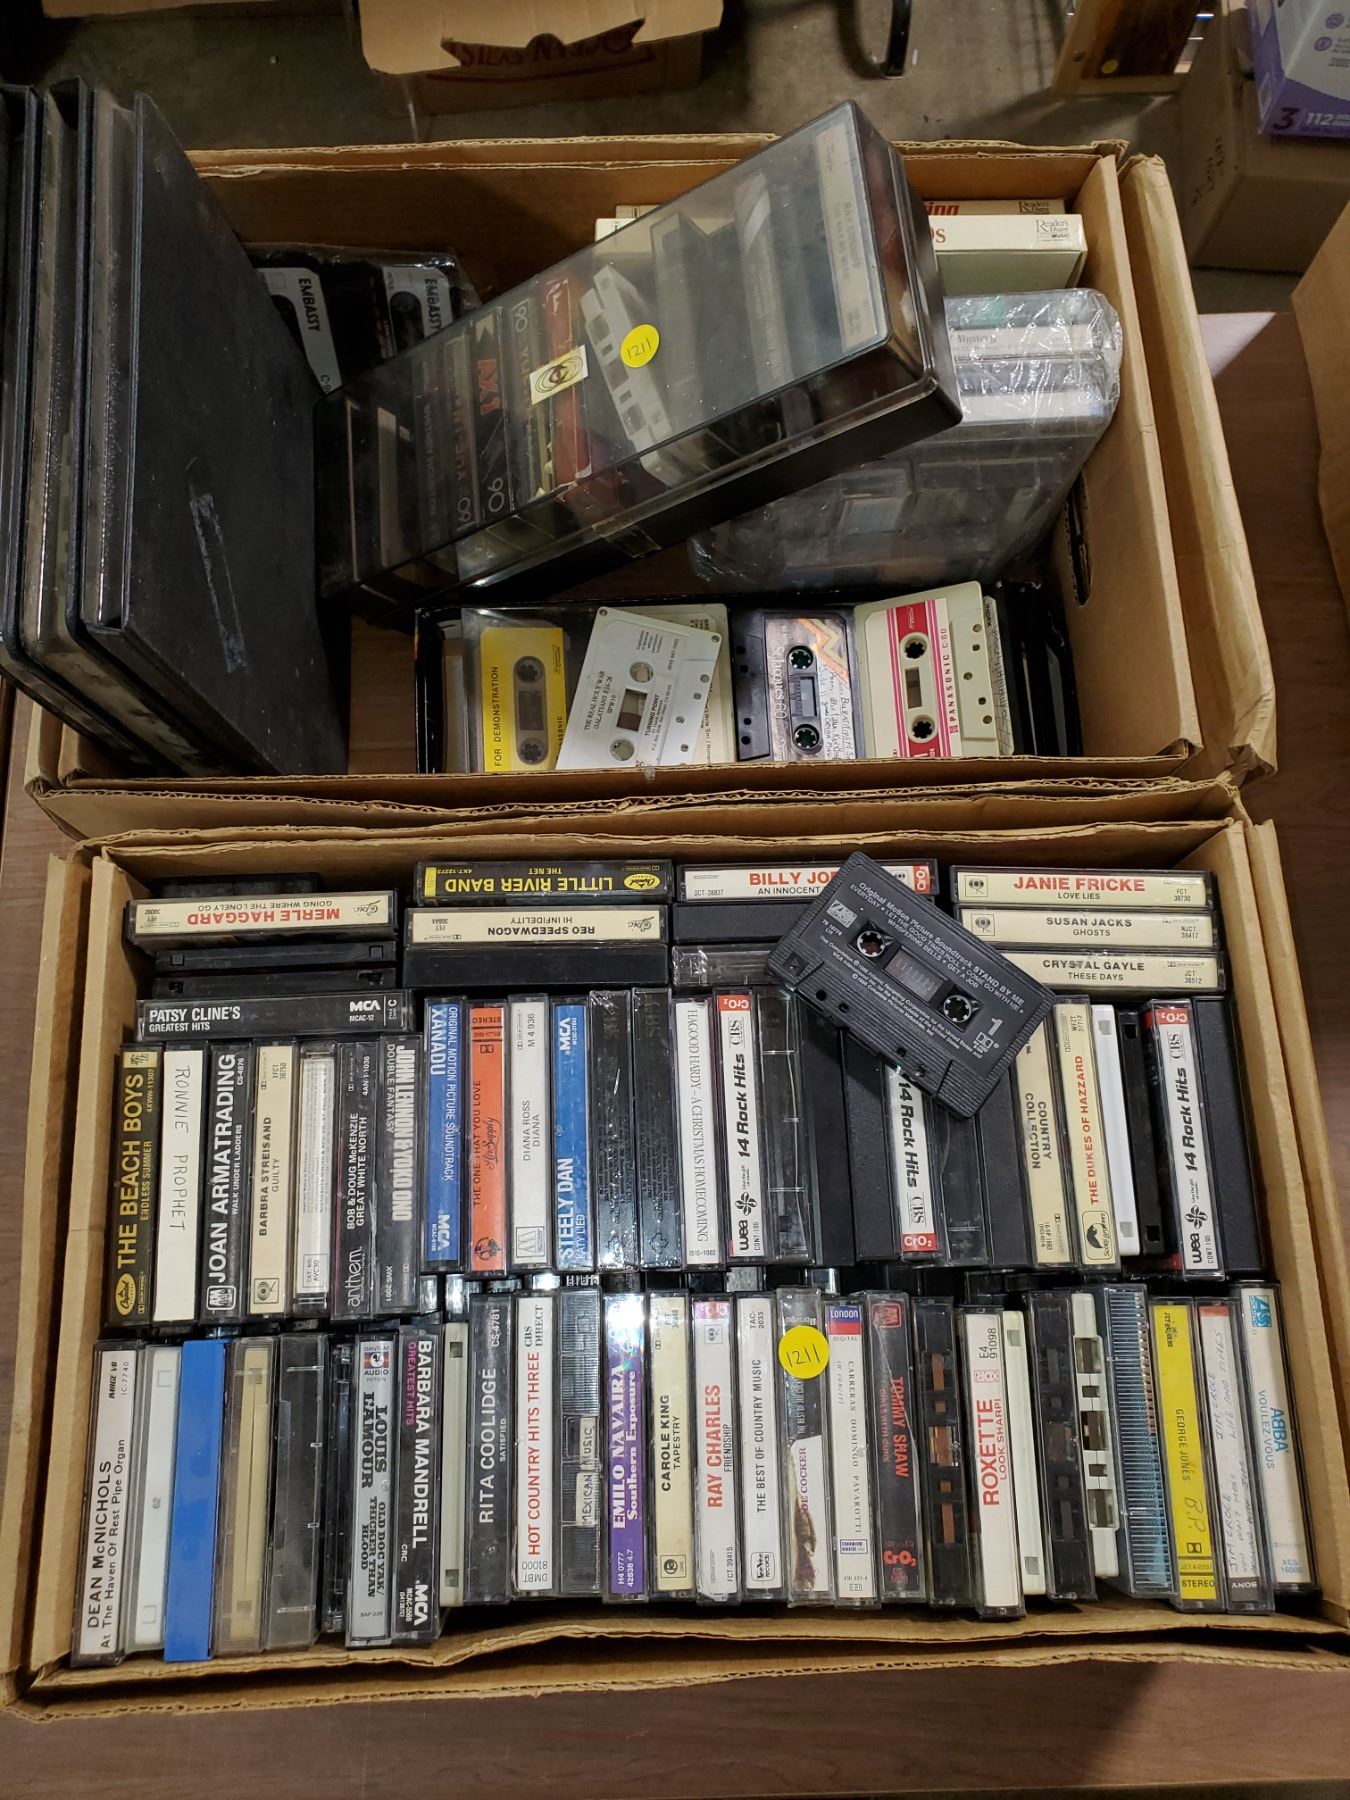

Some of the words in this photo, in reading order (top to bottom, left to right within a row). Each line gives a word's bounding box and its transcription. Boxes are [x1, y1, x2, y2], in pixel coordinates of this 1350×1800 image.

[1272, 107, 1299, 129] 3
[1306, 112, 1333, 125] 112
[298, 277, 320, 332] EMBASSY
[628, 338, 652, 359] 1211
[487, 476, 504, 512] 90
[940, 628, 948, 649] C-60
[591, 685, 601, 702] HOLY
[595, 671, 605, 684] WAR
[943, 654, 956, 722] PANASONIC
[491, 666, 501, 742] DEMONSTRATION
[587, 703, 596, 718] REAL
[644, 712, 656, 736] TURNING
[651, 694, 659, 711] POINT
[777, 703, 786, 719] 60
[444, 877, 495, 892] BAND
[498, 877, 552, 892] RIVER
[556, 876, 614, 893] LITTLE
[749, 871, 801, 886] BILLY
[807, 872, 838, 884] JO
[1014, 877, 1070, 890] JANIE
[1075, 878, 1146, 892] FRICKE
[186, 910, 275, 925] HAGGARD
[279, 908, 340, 921] MERLE
[487, 924, 568, 936] SPEEDWAGON
[509, 916, 561, 925] INFIDELITY
[562, 916, 573, 924] HI
[571, 924, 595, 935] REO
[1046, 917, 1088, 927] SUSAN
[1092, 918, 1132, 927] JACKS
[1073, 929, 1111, 937] GHOSTS
[849, 883, 880, 909] EVERYDAY
[883, 909, 896, 920] LET
[895, 917, 909, 929] THE
[907, 926, 928, 943] GOOD
[926, 940, 945, 956] TIMES
[943, 952, 961, 968] ROLL
[965, 968, 985, 985] COME
[983, 982, 994, 993] GO
[992, 989, 1009, 1003] WITH
[856, 881, 887, 906] Original
[884, 901, 911, 923] Motion
[908, 918, 935, 940] Picture
[933, 936, 974, 968] Soundtrack
[972, 965, 1000, 988] STAND
[998, 984, 1012, 997] BY
[1010, 993, 1025, 1006] ME
[886, 918, 924, 948] WHISPERING
[921, 944, 942, 961] BELLS
[946, 962, 961, 975] GET
[964, 976, 979, 989] JOB
[1043, 959, 1100, 970] CRYSTAL
[1104, 961, 1145, 971] GAYLE
[1067, 972, 1097, 980] THESE
[1100, 973, 1124, 981] DAYS
[149, 1007, 188, 1023] PATSY
[192, 1006, 241, 1021] CLINE'S
[349, 1000, 381, 1012] MCA
[149, 1022, 189, 1033] GREATEST
[192, 1021, 210, 1031] HITS
[430, 1007, 447, 1076] XANADU
[447, 1007, 458, 1046] ORIGINAL
[687, 1010, 700, 1054] HAGOOD
[987, 1016, 1004, 1037] 1
[387, 1044, 395, 1085] DOUBLE
[446, 1048, 457, 1081] MOTION
[689, 1055, 702, 1089] HARDY
[733, 1054, 748, 1087] Hits
[123, 1074, 144, 1132] BOYS
[174, 1065, 190, 1133] RONNIE
[445, 1083, 456, 1120] PICTURE
[690, 1097, 702, 1105] A
[898, 1082, 912, 1101] 14
[1074, 1055, 1088, 1114] HAZZARD
[1175, 1067, 1189, 1103] Hits
[386, 1087, 394, 1133] FANTASY
[522, 1100, 531, 1125] ROSS
[735, 1091, 750, 1134] Rock
[901, 1104, 916, 1148] Rock
[1081, 1117, 1091, 1132] OF
[1181, 1106, 1195, 1148] Rock
[211, 1054, 235, 1214] ARMATRADING
[233, 1124, 242, 1161] LADDERS
[358, 1116, 368, 1153] NORTH
[522, 1127, 531, 1161] DIANA
[533, 1114, 541, 1147] DIANA
[691, 1105, 705, 1165] CHRISTMAS
[738, 1138, 751, 1158] 14
[1025, 1093, 1041, 1169] COLLECTION
[1037, 1101, 1052, 1159] COUNTRY
[141, 1140, 152, 1179] SUMMER
[261, 1117, 271, 1182] STREISAND
[444, 1122, 456, 1181] SOUNDTRACK
[1084, 1136, 1096, 1177] DUKES
[1184, 1152, 1198, 1172] 14
[119, 1140, 141, 1215] BEACH
[232, 1162, 241, 1190] UNDER
[271, 1158, 280, 1192] GUILTY
[357, 1154, 366, 1188] WHITE
[557, 1158, 574, 1193] DAN
[905, 1151, 919, 1188] Hits
[140, 1181, 151, 1220] ENDLESS
[169, 1154, 188, 1230] PROPHET
[232, 1192, 240, 1215] WALK
[694, 1166, 708, 1242] HOMECOMING
[1088, 1180, 1099, 1205] THE
[259, 1186, 269, 1236] BARBRA
[356, 1196, 365, 1226] GREAT
[557, 1196, 574, 1259] STEELY
[117, 1223, 138, 1269] THE
[438, 1214, 450, 1250] MCA
[208, 1222, 228, 1283] JOAN
[534, 1304, 544, 1347] DIRECT
[831, 1310, 859, 1319] LONDON
[405, 1341, 416, 1397] GREATEST
[786, 1342, 821, 1369] 1211
[415, 1340, 432, 1433] BARBARA
[527, 1352, 540, 1402] THREE
[752, 1359, 762, 1392] MUSIC
[405, 1399, 414, 1425] HITS
[481, 1368, 496, 1470] COOLIDGE
[611, 1366, 625, 1458] NAVAIRA
[626, 1370, 637, 1441] Exposure
[659, 1395, 670, 1429] KING
[753, 1395, 764, 1443] COUNTRY
[890, 1377, 905, 1428] TOMMY
[361, 1392, 375, 1488] L'AMOUR
[375, 1405, 388, 1473] LOUIS
[499, 1418, 507, 1462] SATISFIED
[527, 1407, 540, 1442] HITS
[672, 1415, 681, 1470] TAPESTRY
[704, 1385, 720, 1467] CHARLES
[1175, 1408, 1186, 1441] GEORGE
[1258, 1389, 1275, 1469] VOULEZ-VOUS
[1269, 1408, 1288, 1453] ABBA
[581, 1427, 593, 1467] MUSIC
[660, 1433, 671, 1492] CAROLE
[722, 1424, 732, 1472] FRIENDSHIP
[755, 1446, 765, 1459] OF
[893, 1434, 909, 1478] SHAW
[976, 1398, 1000, 1505] ROXETTE
[1179, 1442, 1191, 1481] JONES
[412, 1438, 429, 1549] MANDRELL
[528, 1446, 540, 1520] COUNTRY
[626, 1446, 638, 1520] Southern
[707, 1473, 723, 1508] RAY
[755, 1462, 766, 1489] BEST
[92, 1460, 112, 1569] McNICHOLS
[480, 1474, 495, 1523] RITA
[580, 1474, 594, 1525] MEXICAN
[612, 1464, 626, 1529] EMILO
[756, 1492, 767, 1513] THE
[528, 1524, 541, 1555] HOT
[87, 1576, 103, 1629] DEAN
[1230, 1582, 1258, 1590] SONY
